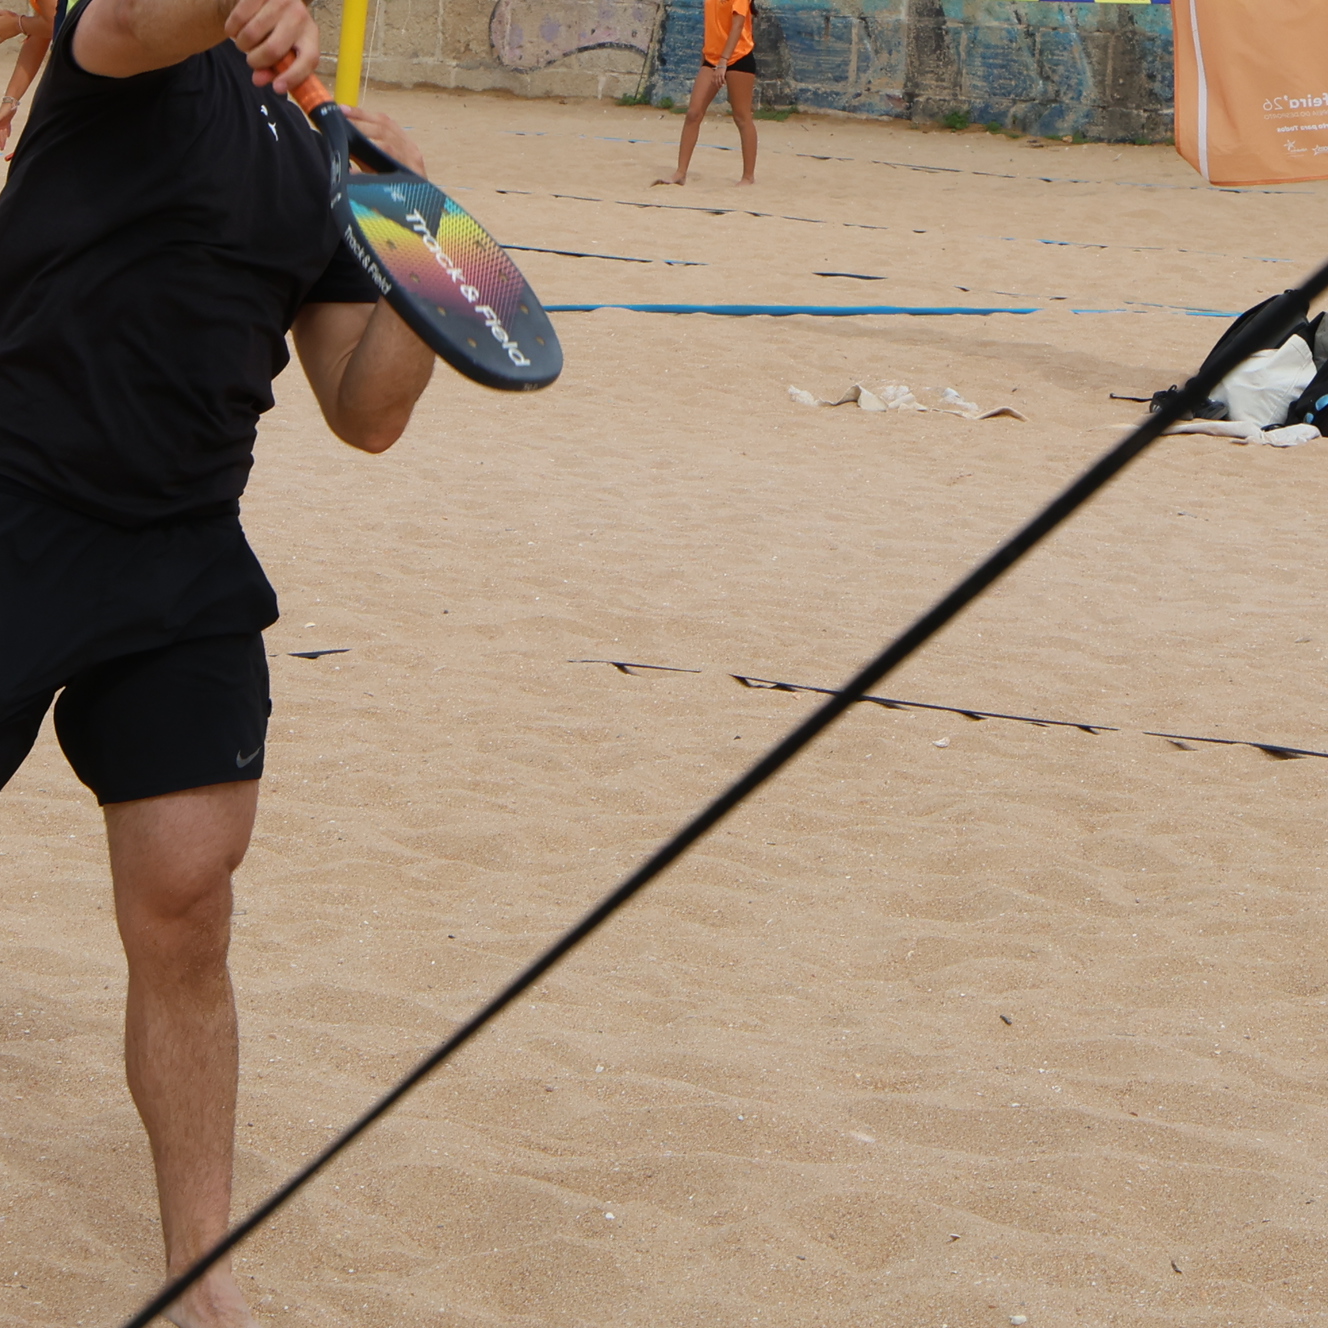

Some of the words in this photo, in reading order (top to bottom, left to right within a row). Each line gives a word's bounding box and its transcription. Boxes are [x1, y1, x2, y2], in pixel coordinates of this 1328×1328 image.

[344, 224, 366, 260] Track
[405, 208, 466, 283] Track
[460, 284, 479, 303] &
[475, 304, 531, 367] Field
